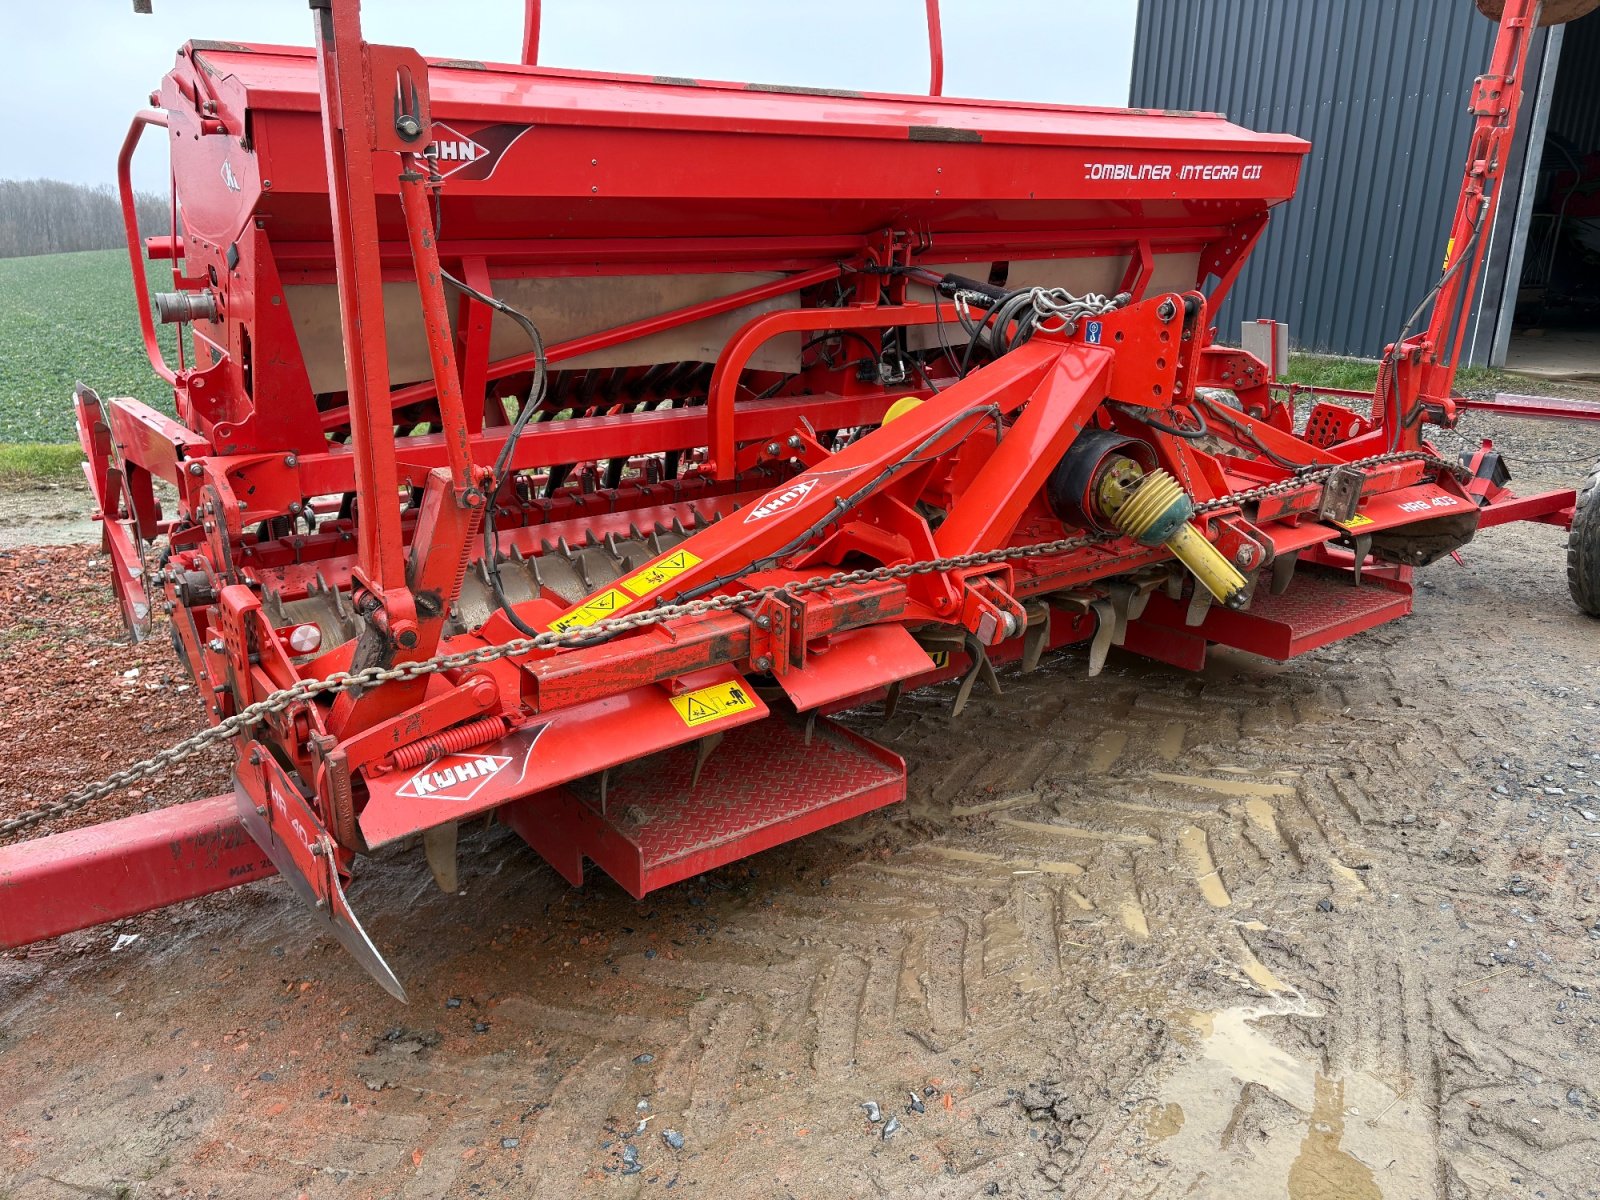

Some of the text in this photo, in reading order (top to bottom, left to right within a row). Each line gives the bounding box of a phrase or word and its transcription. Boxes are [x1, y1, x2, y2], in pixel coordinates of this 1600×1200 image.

[1179, 165, 1238, 180] INTEGRA
[1242, 165, 1262, 179] GII
[752, 483, 812, 519] KUHN
[1398, 495, 1457, 513] HRB 403
[411, 756, 499, 796] KUHN
